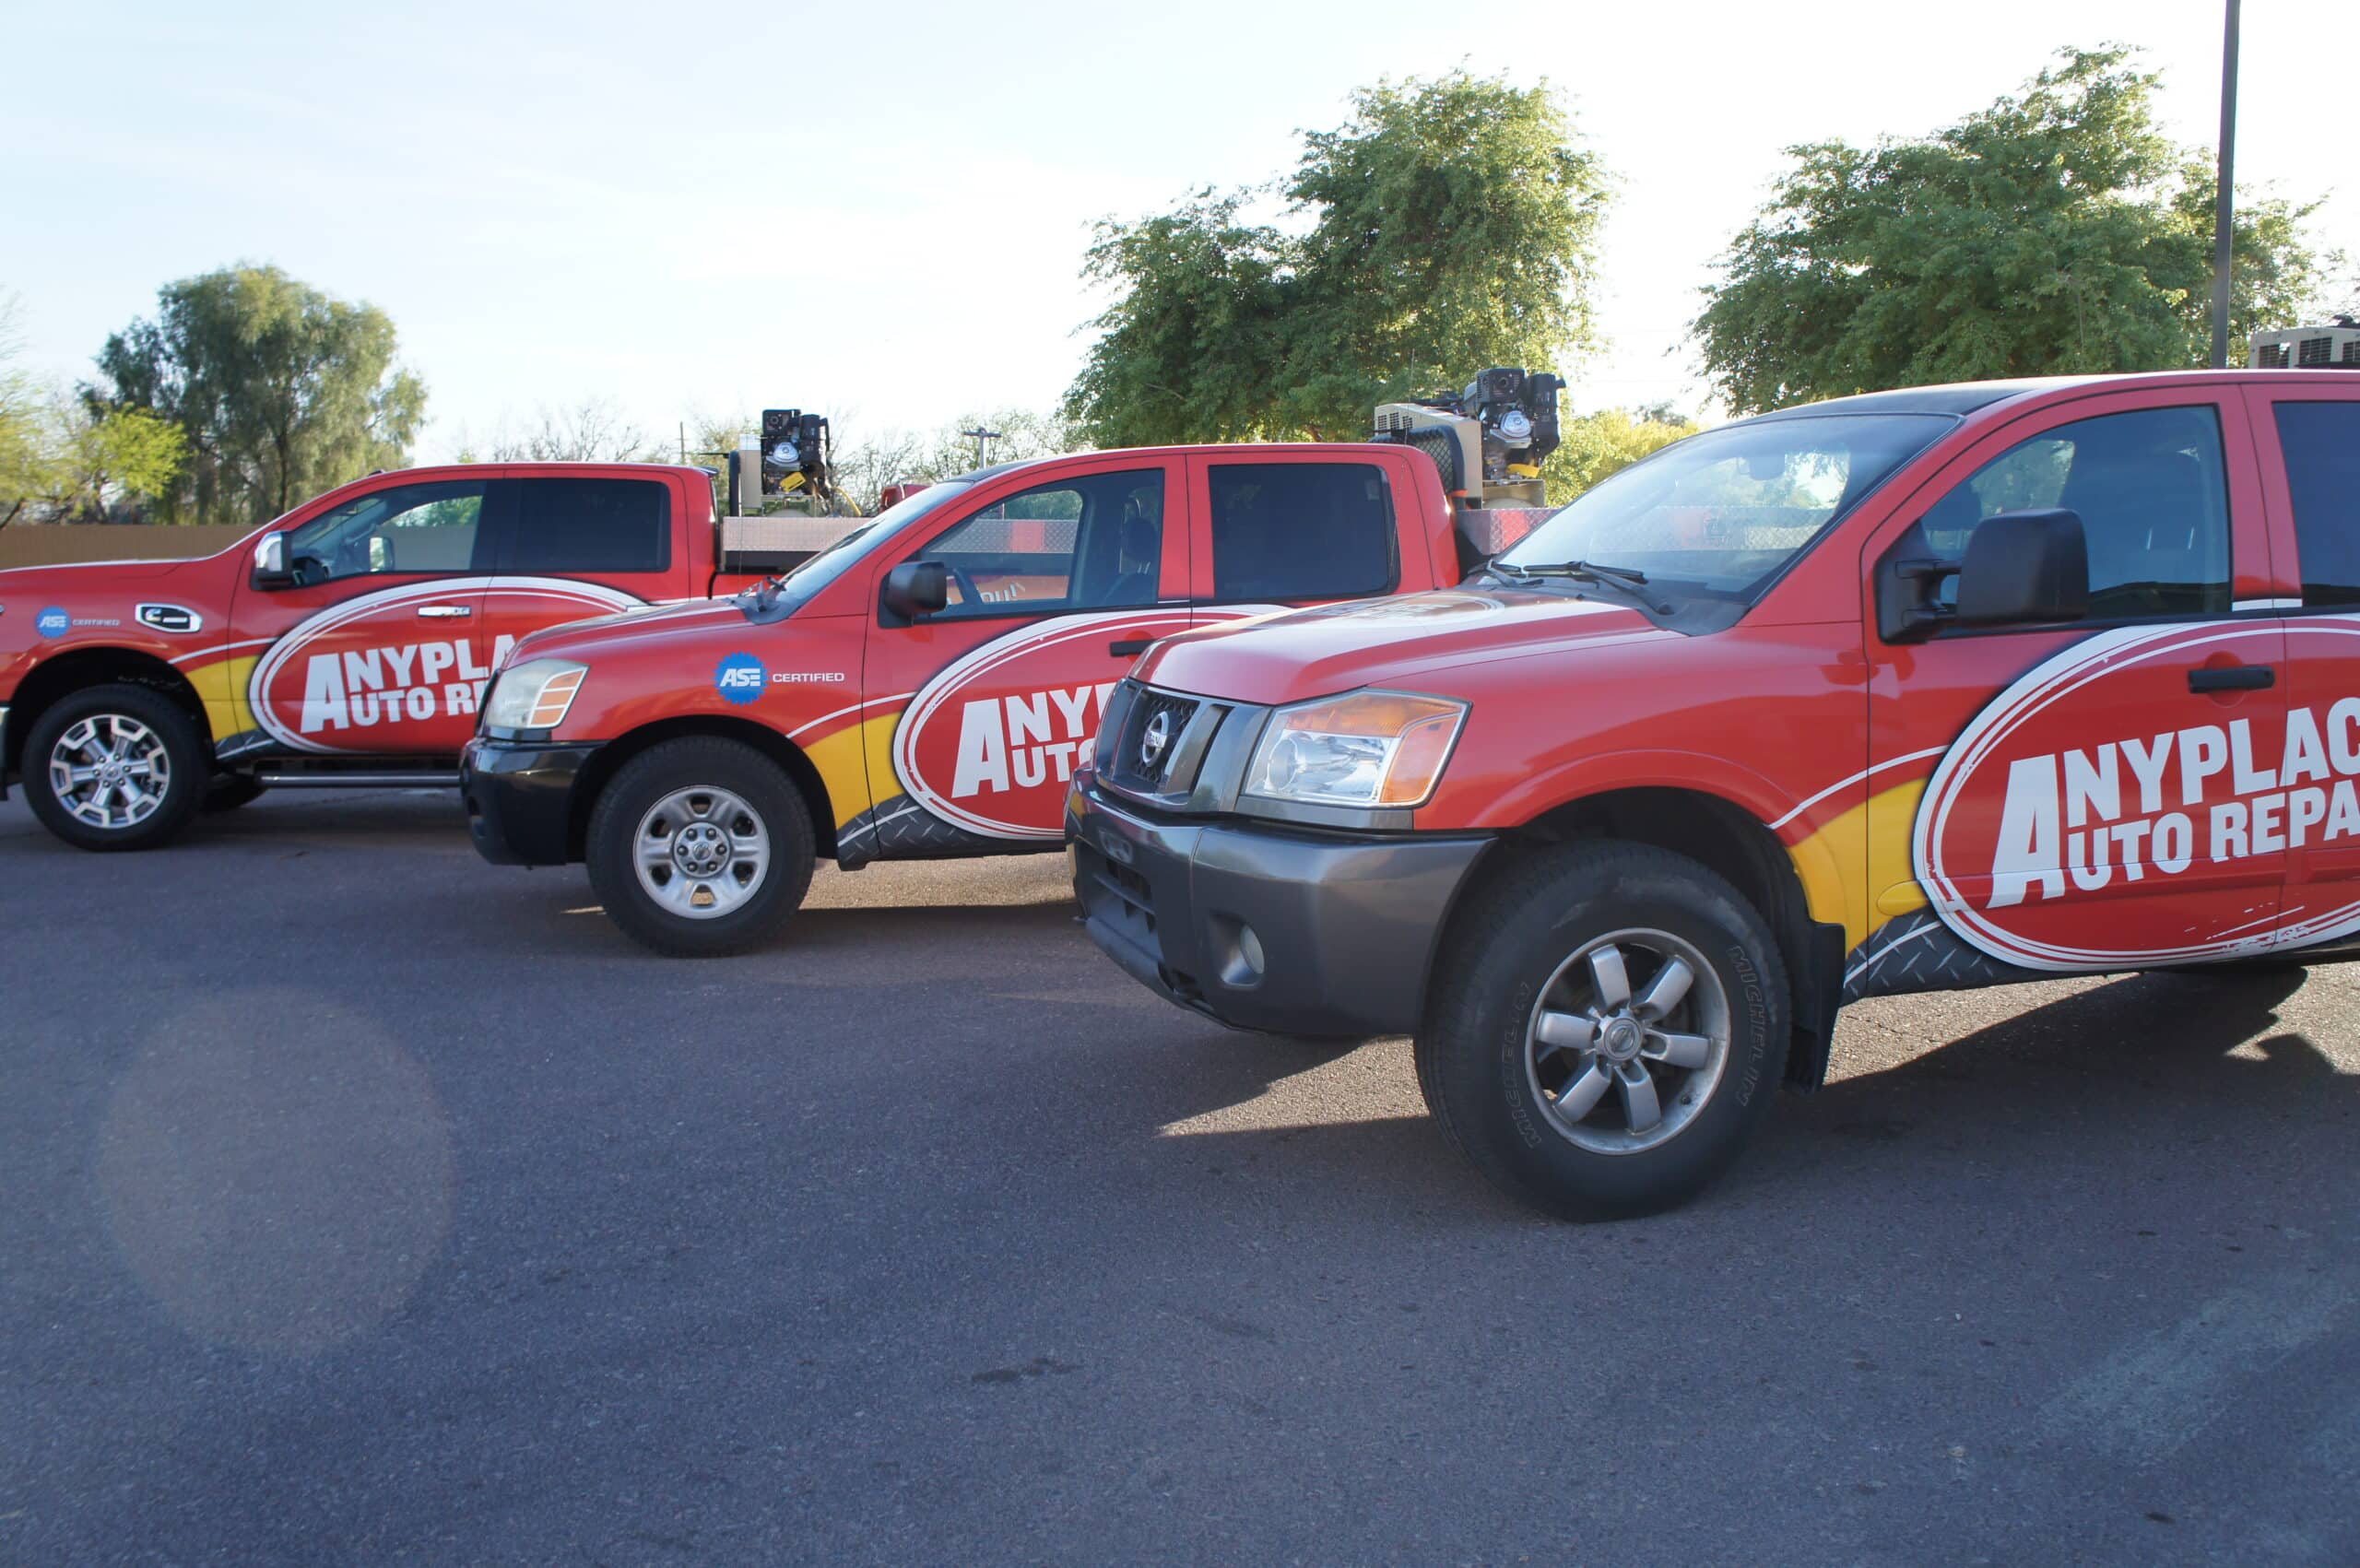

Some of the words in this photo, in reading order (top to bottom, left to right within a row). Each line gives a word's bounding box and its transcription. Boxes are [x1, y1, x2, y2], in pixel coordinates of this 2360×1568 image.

[39, 615, 66, 628] ASE
[719, 668, 761, 687] ASE
[773, 672, 844, 683] CERTIFIED
[1726, 945, 1765, 1107] MICHELIN
